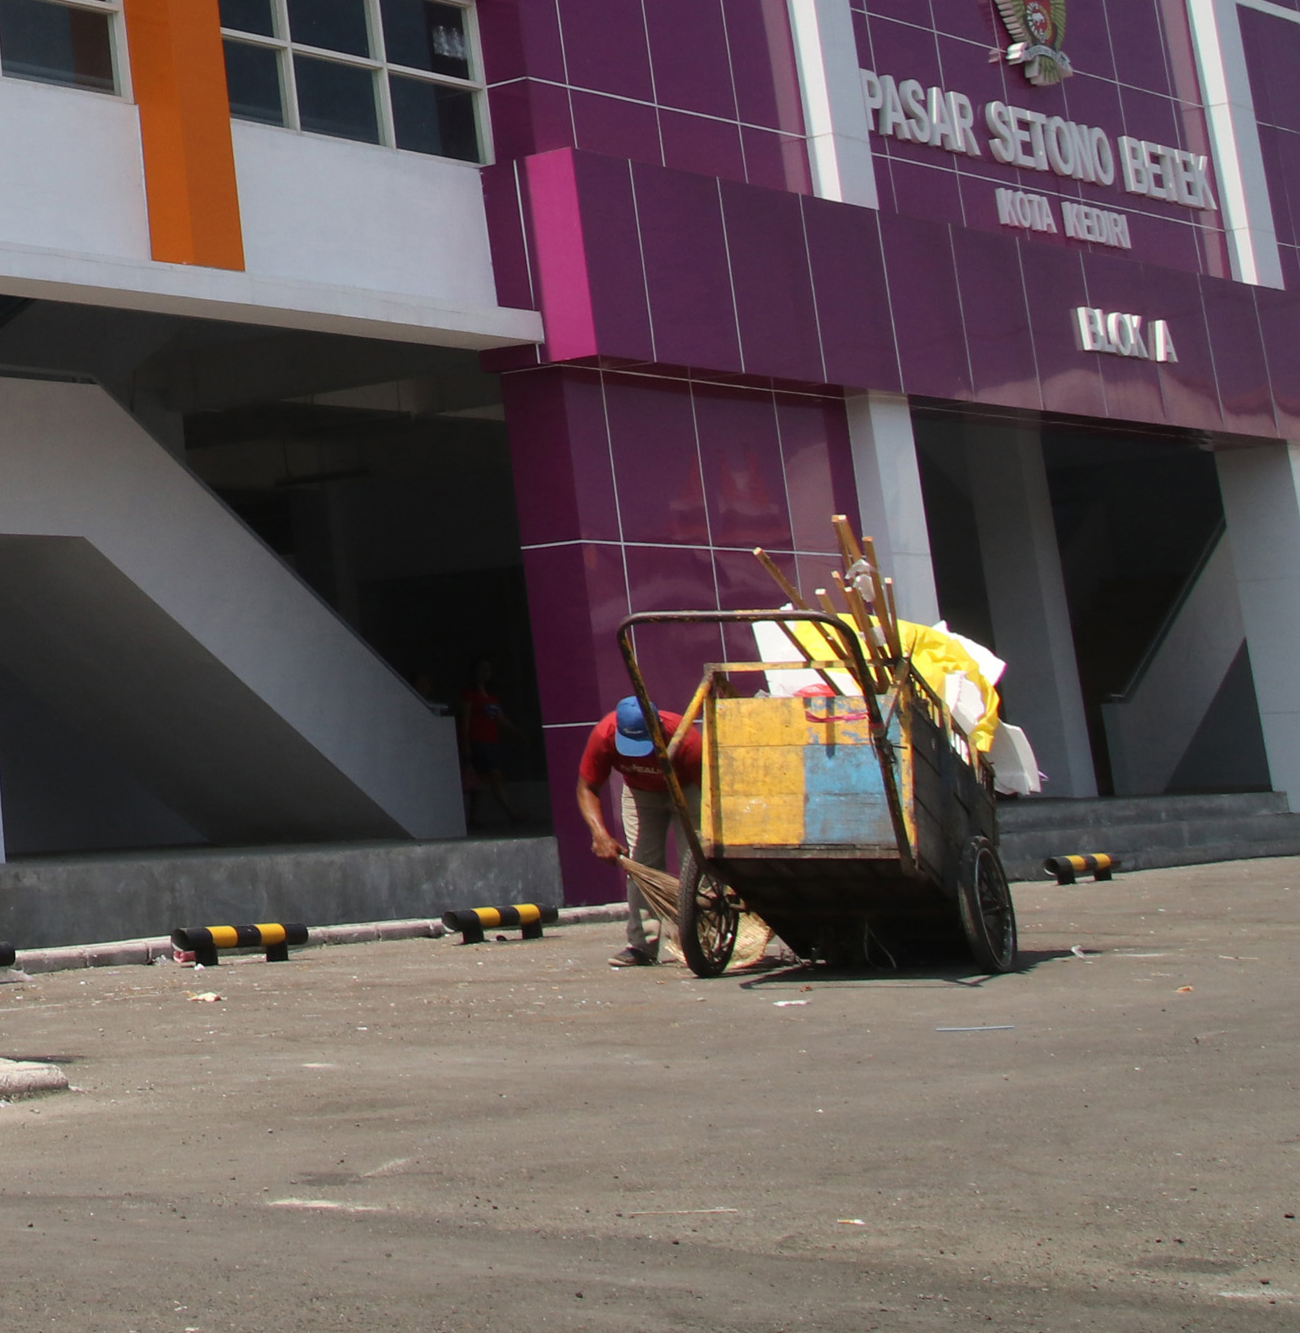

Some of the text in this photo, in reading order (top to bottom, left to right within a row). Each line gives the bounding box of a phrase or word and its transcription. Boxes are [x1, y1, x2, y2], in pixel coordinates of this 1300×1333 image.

[861, 68, 1218, 211] PASAR SETONO BETEK
[995, 187, 1132, 250] KOTA KEDIRI
[1076, 306, 1179, 363] BLOK A
